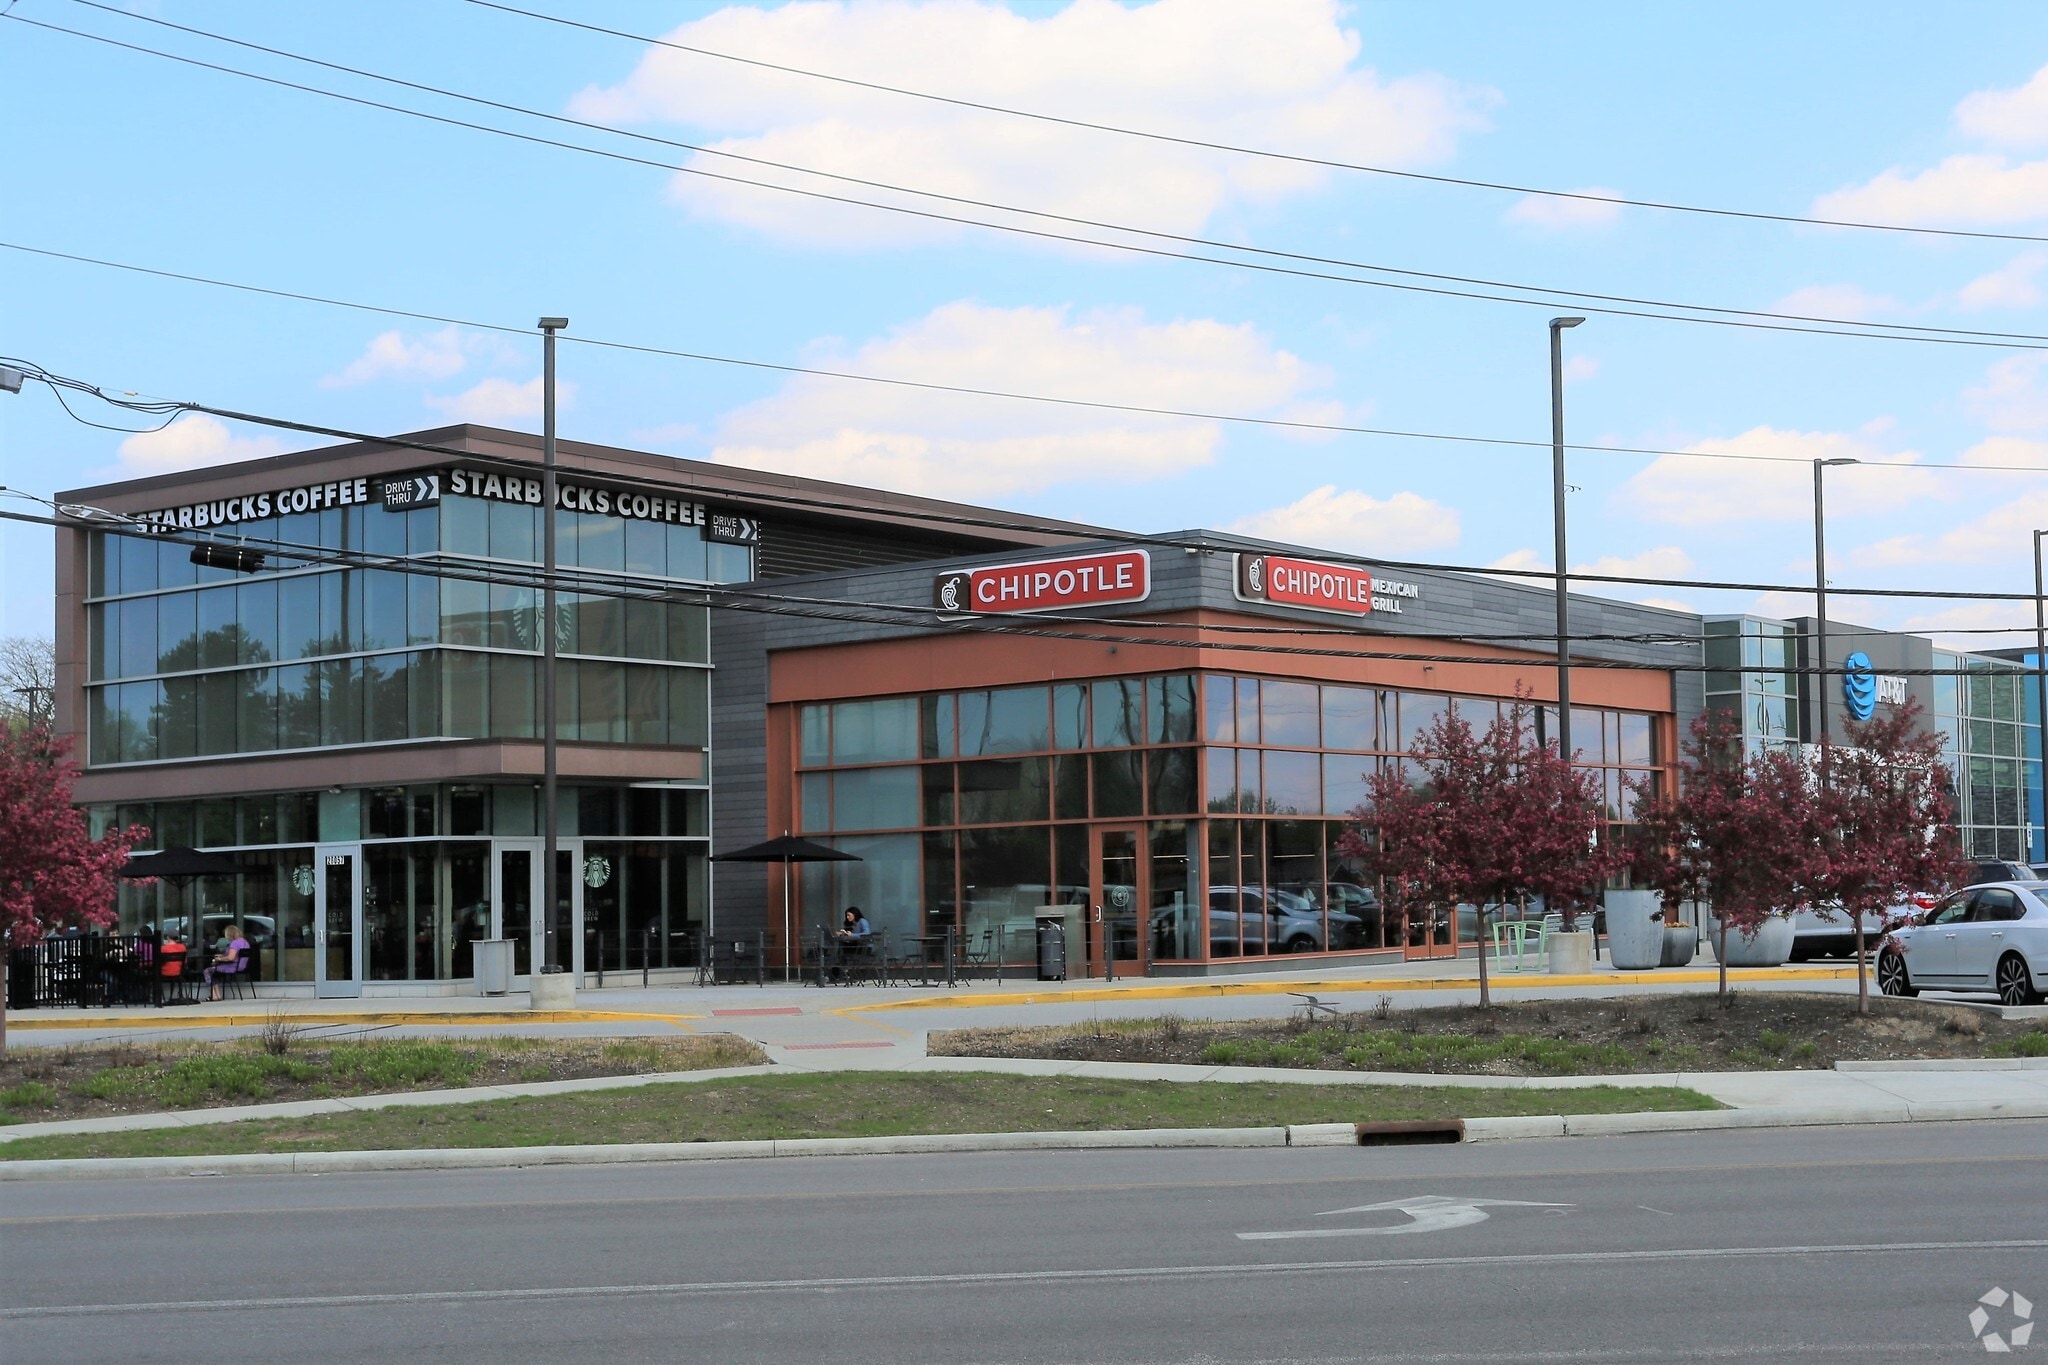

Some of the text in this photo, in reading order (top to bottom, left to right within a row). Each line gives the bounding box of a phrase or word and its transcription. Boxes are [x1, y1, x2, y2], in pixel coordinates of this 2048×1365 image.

[385, 480, 412, 495] DRIVE
[135, 478, 367, 533] STARBUCKS COFFEE
[386, 492, 411, 505] THRU
[617, 493, 706, 526] COFFEE
[713, 515, 737, 528] DRIVE
[713, 525, 736, 538] THRU
[977, 563, 1134, 603] CHIPOTLE
[1272, 566, 1368, 604] CHIPOTLE
[1371, 578, 1419, 598] MEXICAN
[1371, 597, 1403, 613] GRILL
[1875, 674, 1907, 705] AT&T
